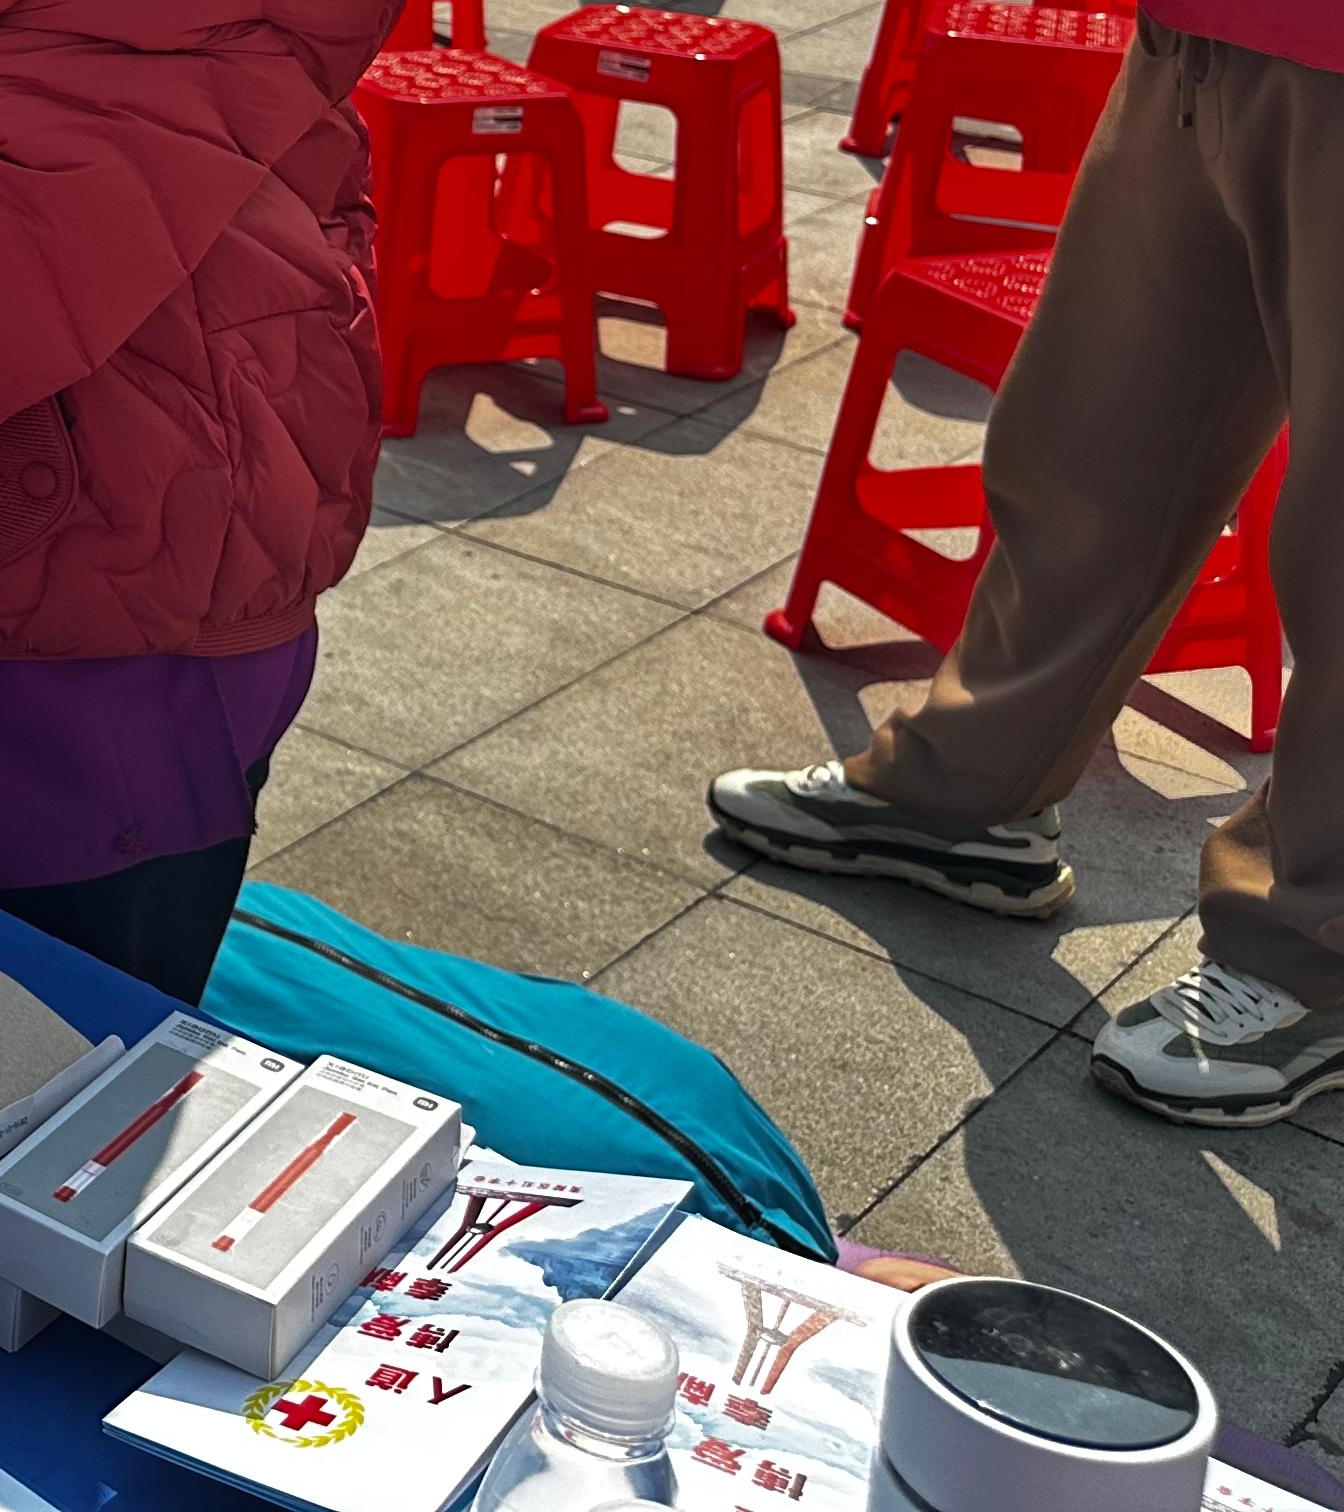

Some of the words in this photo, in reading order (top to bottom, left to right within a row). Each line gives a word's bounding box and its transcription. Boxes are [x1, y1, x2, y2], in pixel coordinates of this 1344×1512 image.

[357, 1265, 457, 1302] 奉献
[360, 1312, 462, 1355] 博爱
[364, 1362, 473, 1407] 人道
[676, 1372, 774, 1430] 奉献
[689, 1435, 808, 1503] 博爱
